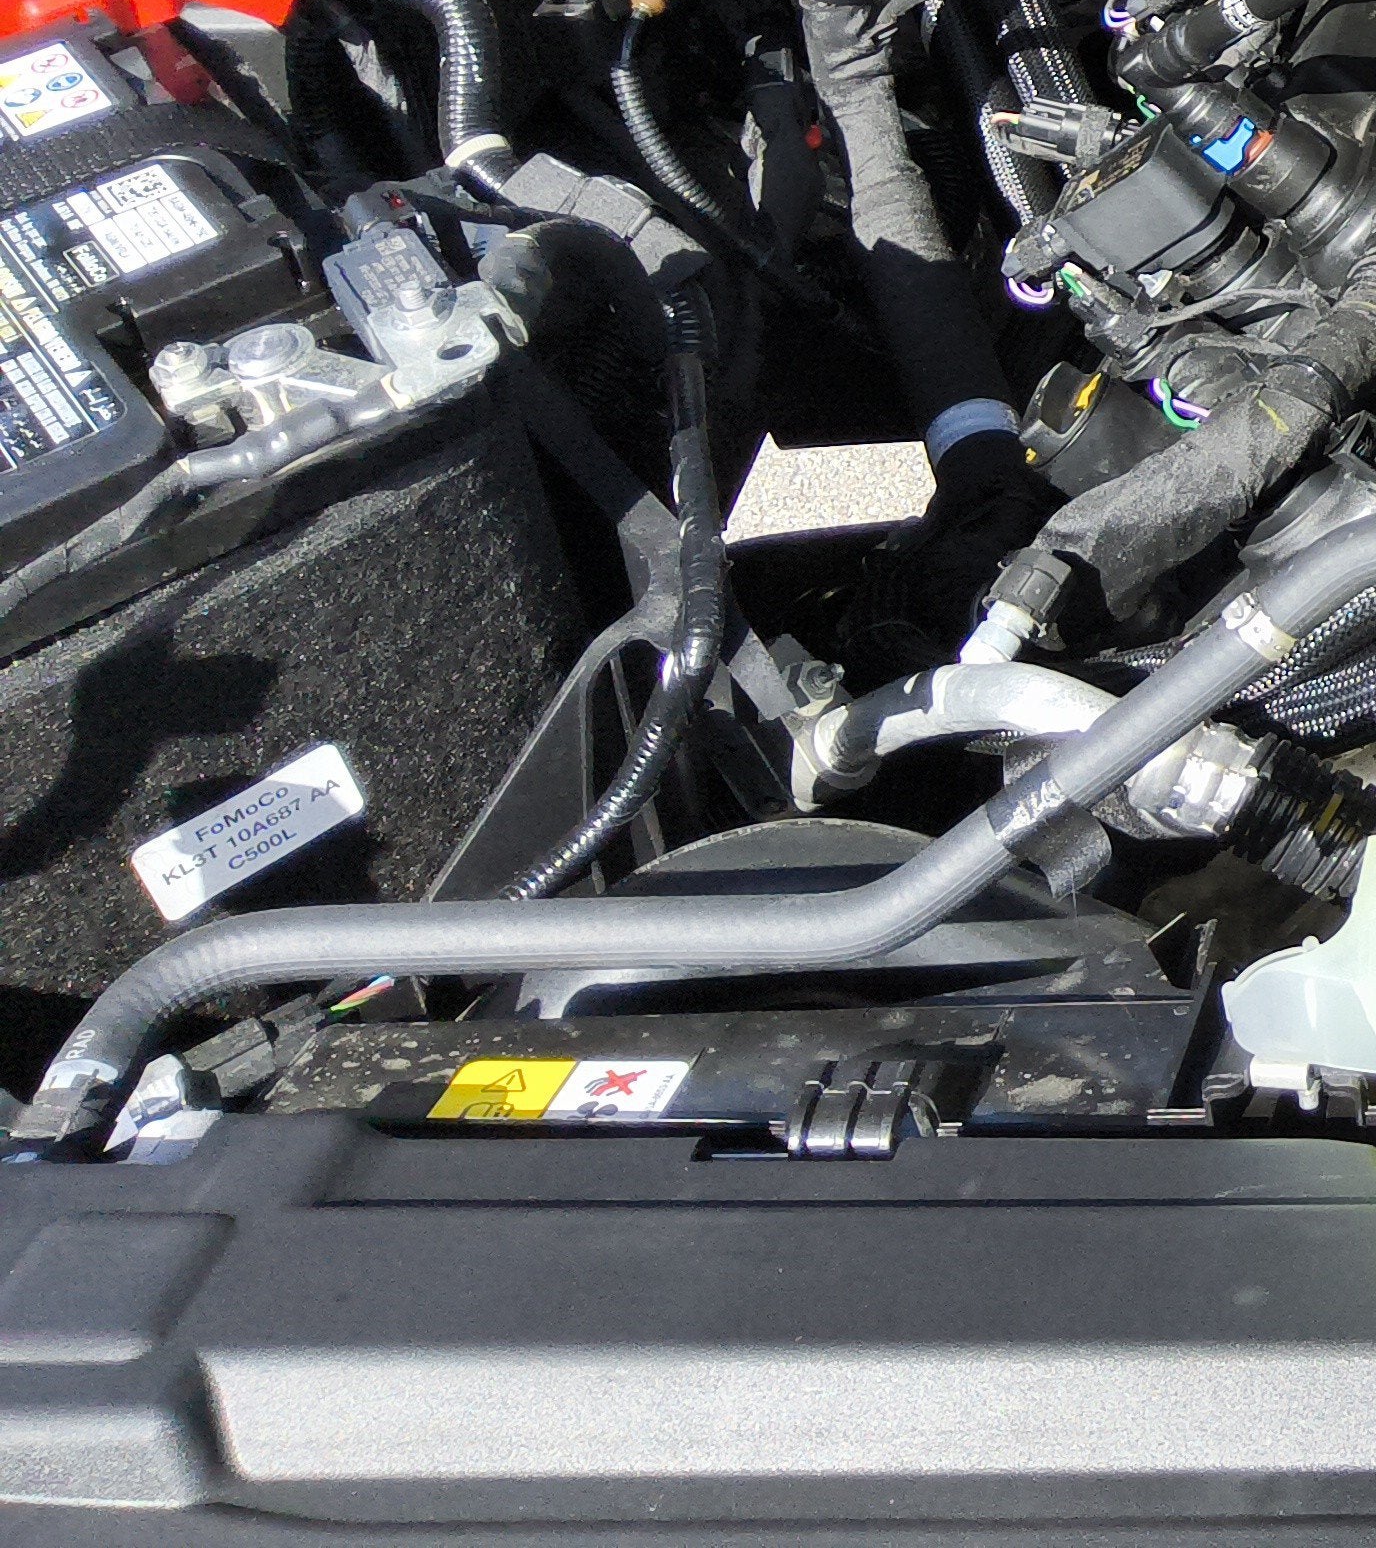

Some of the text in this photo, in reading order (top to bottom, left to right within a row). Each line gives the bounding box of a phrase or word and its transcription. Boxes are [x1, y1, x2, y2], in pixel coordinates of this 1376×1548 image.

[161, 779, 341, 886] KL3T 10A687 AA
[194, 786, 289, 843] FoMoCo
[228, 828, 298, 870] C500L
